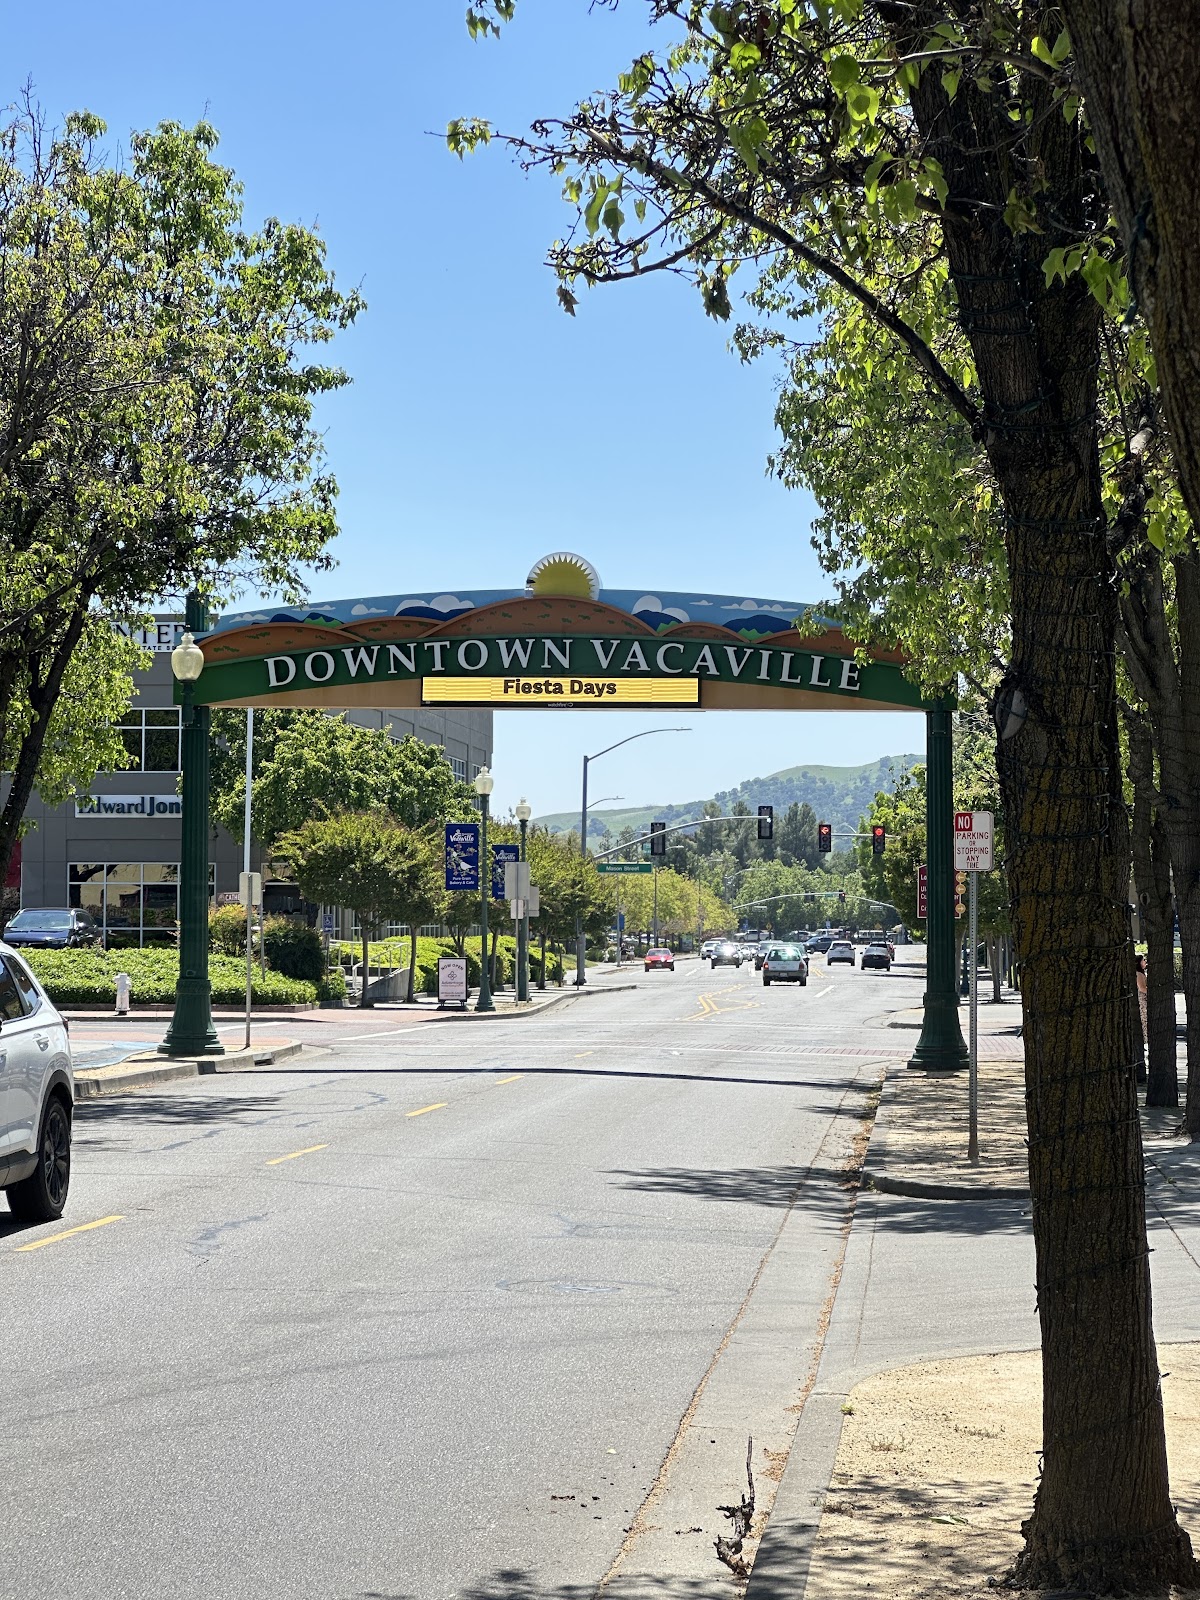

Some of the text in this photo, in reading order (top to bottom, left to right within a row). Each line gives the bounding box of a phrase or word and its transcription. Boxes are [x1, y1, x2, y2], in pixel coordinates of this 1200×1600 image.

[264, 638, 862, 691] DOWNTOWN VACAVILLE
[503, 679, 617, 697] Fiesta Days
[147, 796, 183, 816] Jon
[958, 815, 971, 829] NO
[956, 847, 989, 855] STOPPING
